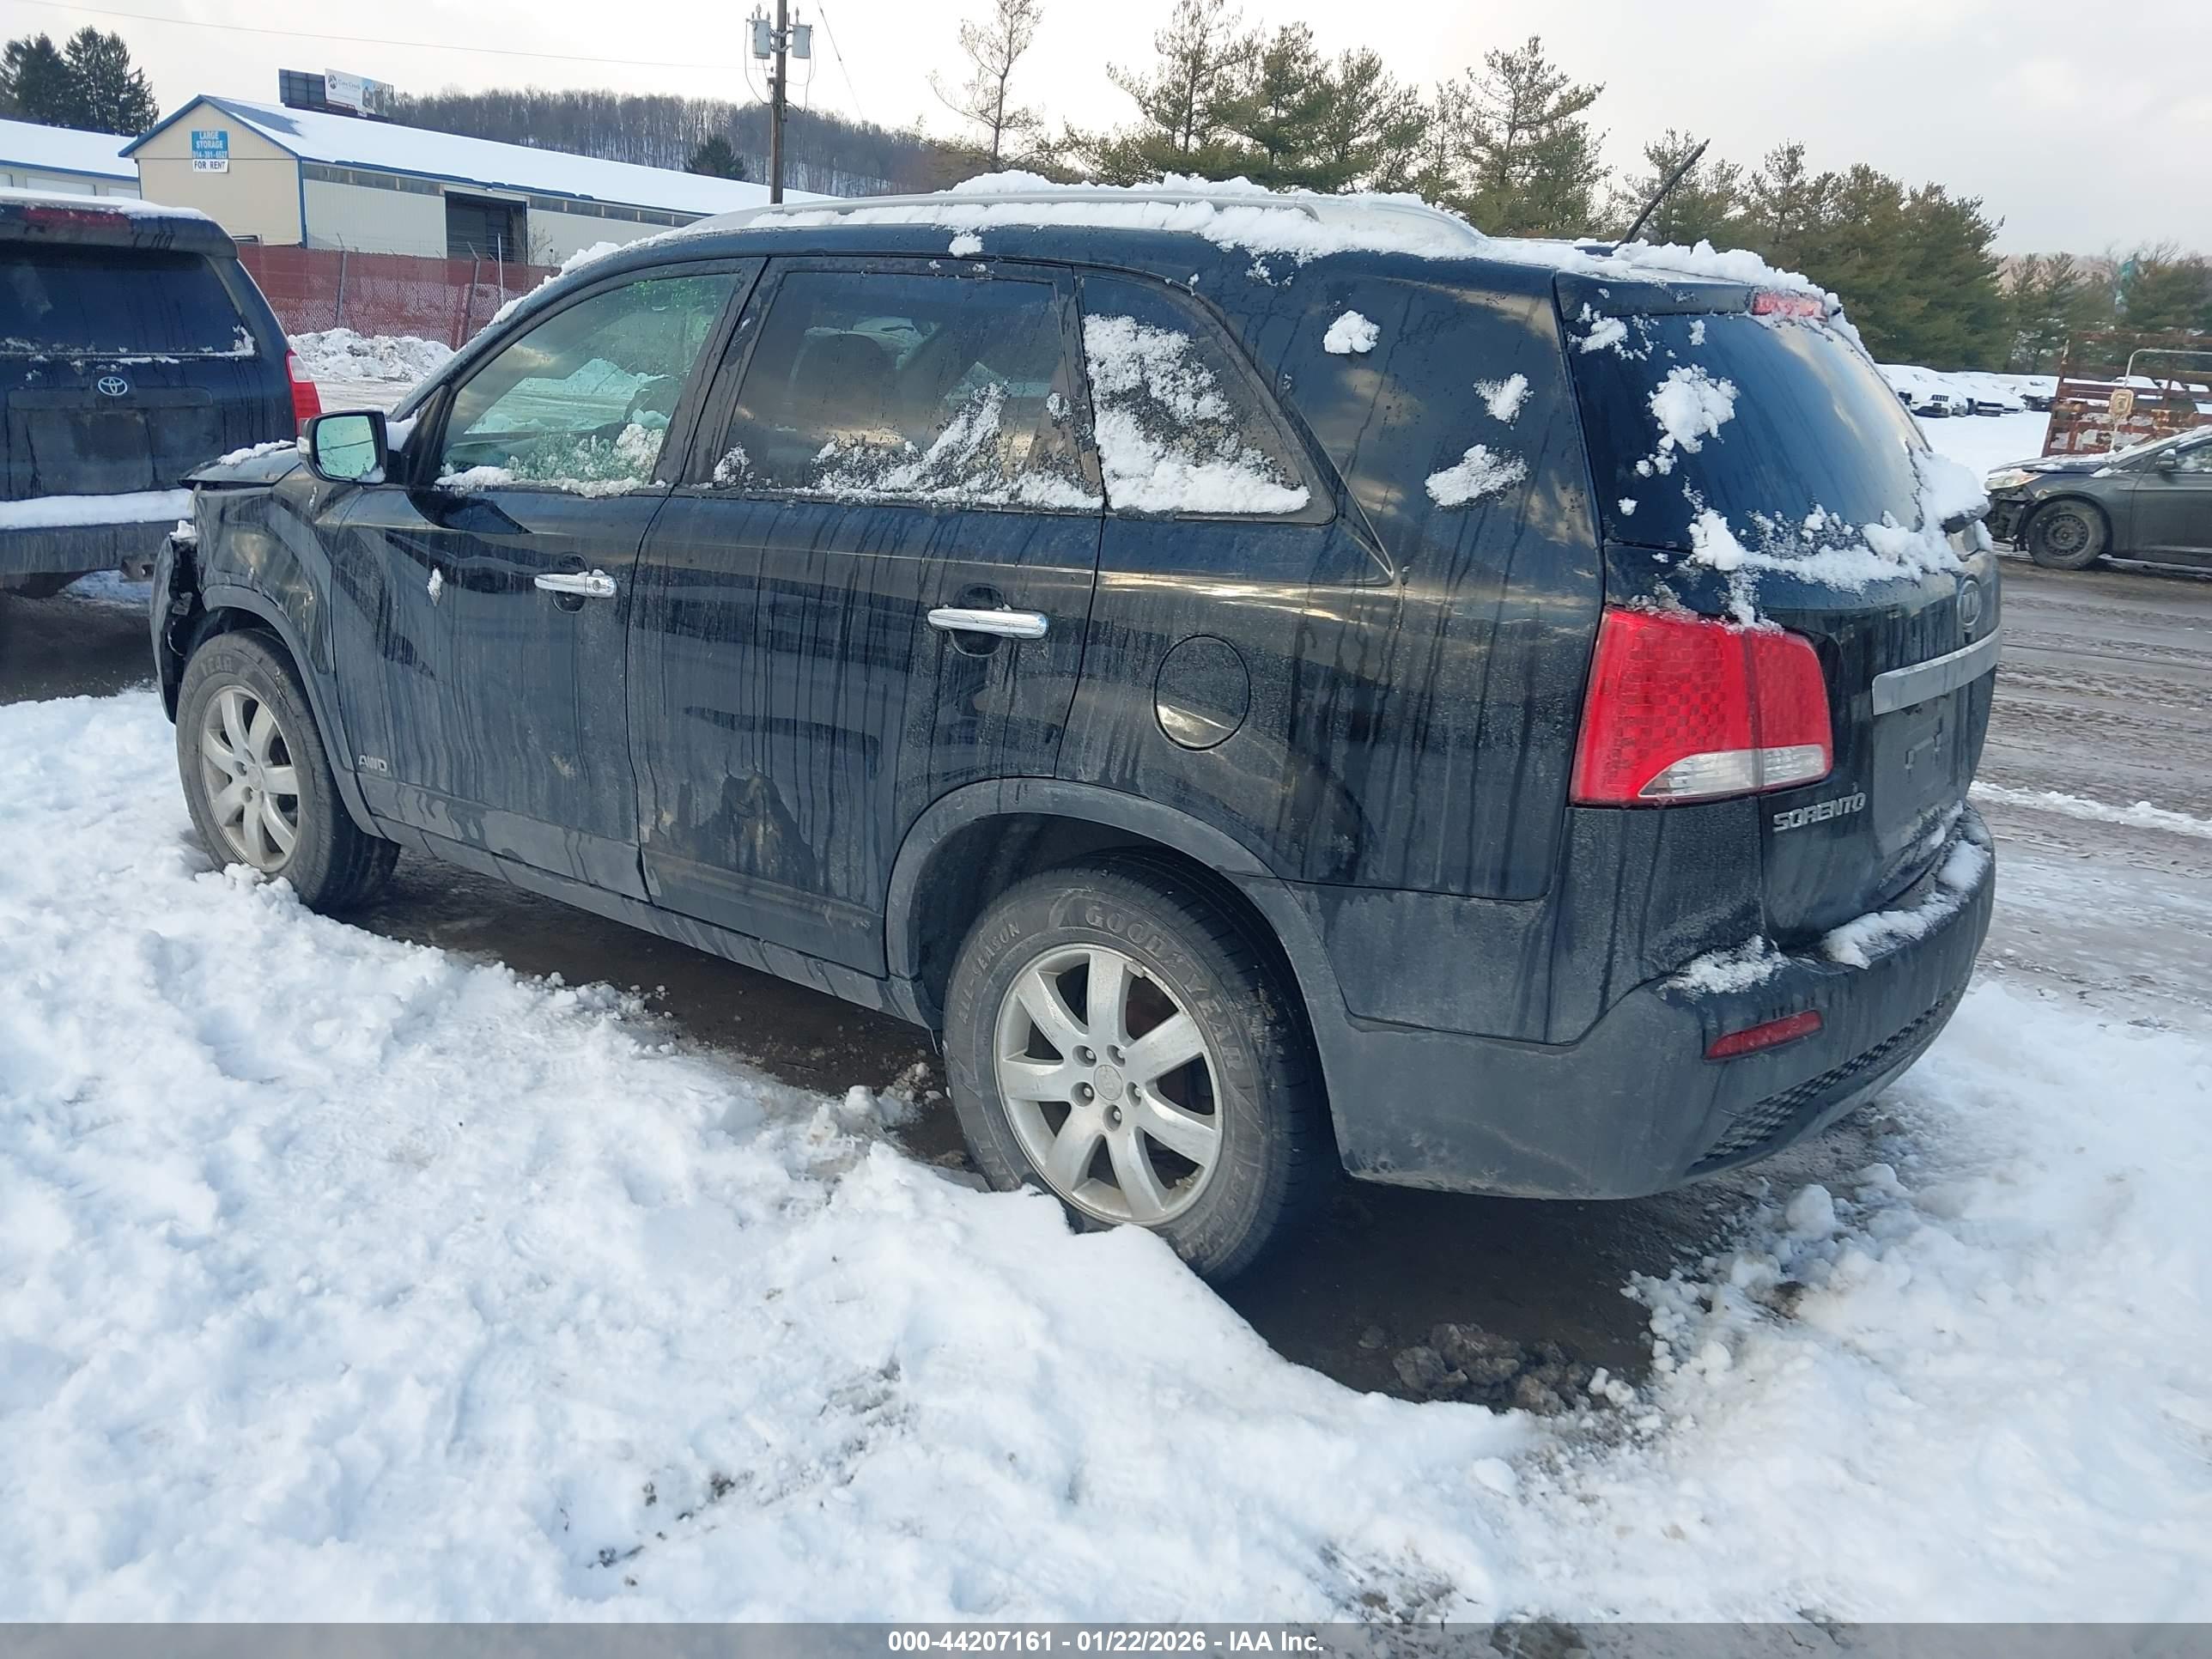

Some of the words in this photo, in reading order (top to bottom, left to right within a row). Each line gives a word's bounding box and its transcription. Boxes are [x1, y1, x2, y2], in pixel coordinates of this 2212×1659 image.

[199, 131, 219, 140] LARGE
[196, 140, 223, 149] STORAGE
[194, 161, 207, 169] FOR
[210, 161, 226, 169] RENT
[359, 755, 387, 772] AWD
[1772, 792, 1867, 832] SORENTO
[957, 921, 1021, 1024] ALL-SEASON
